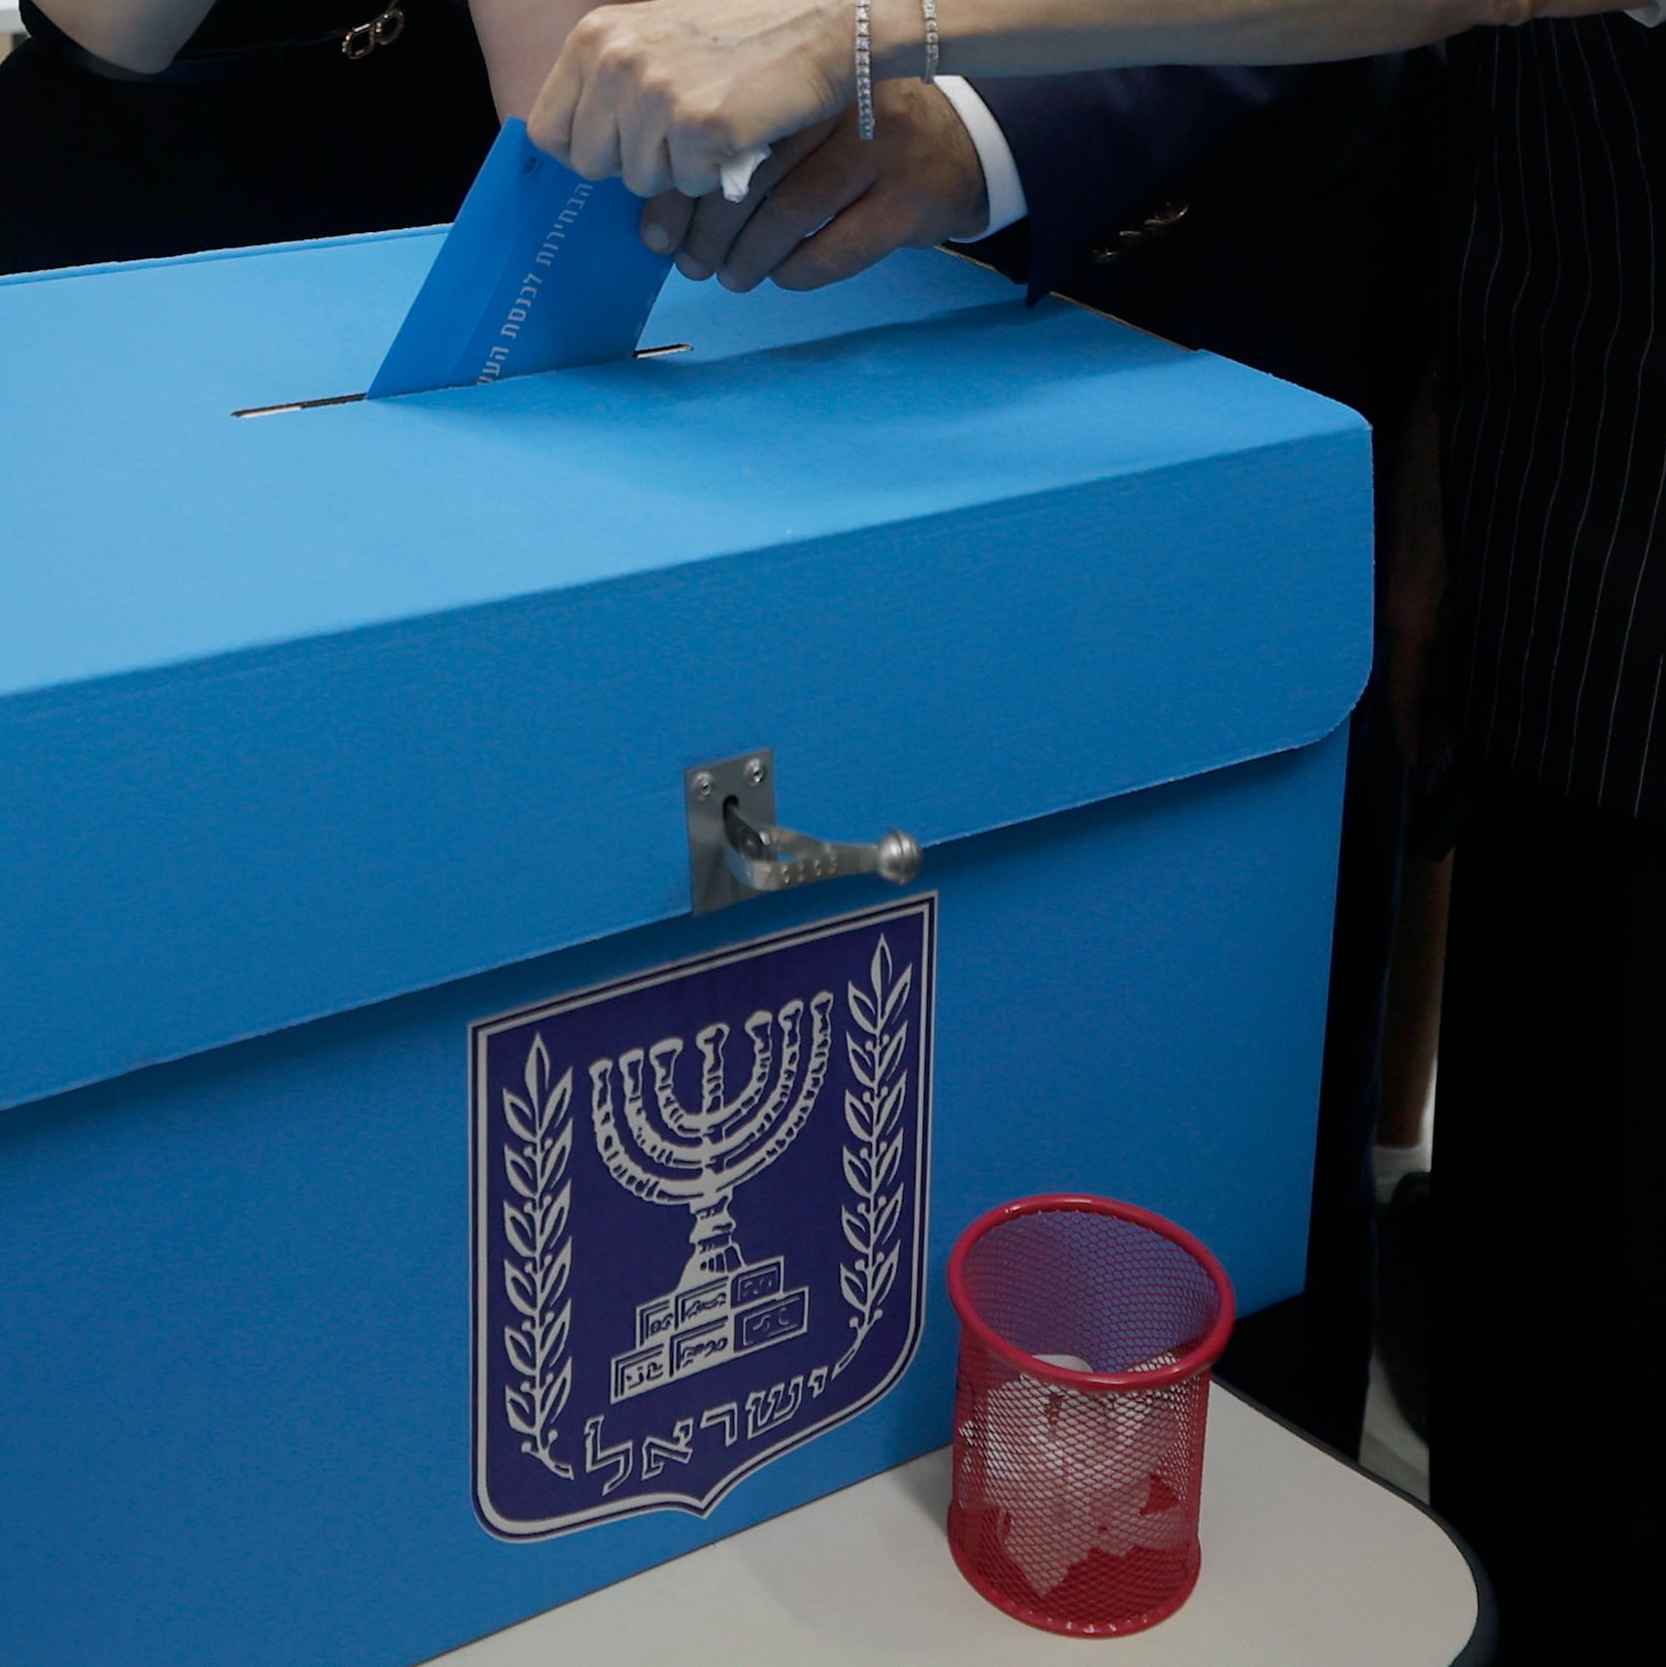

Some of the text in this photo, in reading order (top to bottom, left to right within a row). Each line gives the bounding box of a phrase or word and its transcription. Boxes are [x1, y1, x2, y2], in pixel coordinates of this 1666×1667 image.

[536, 183, 595, 267] הבחירות
[500, 273, 542, 340] לכנסת
[584, 1366, 829, 1496] ישראל
